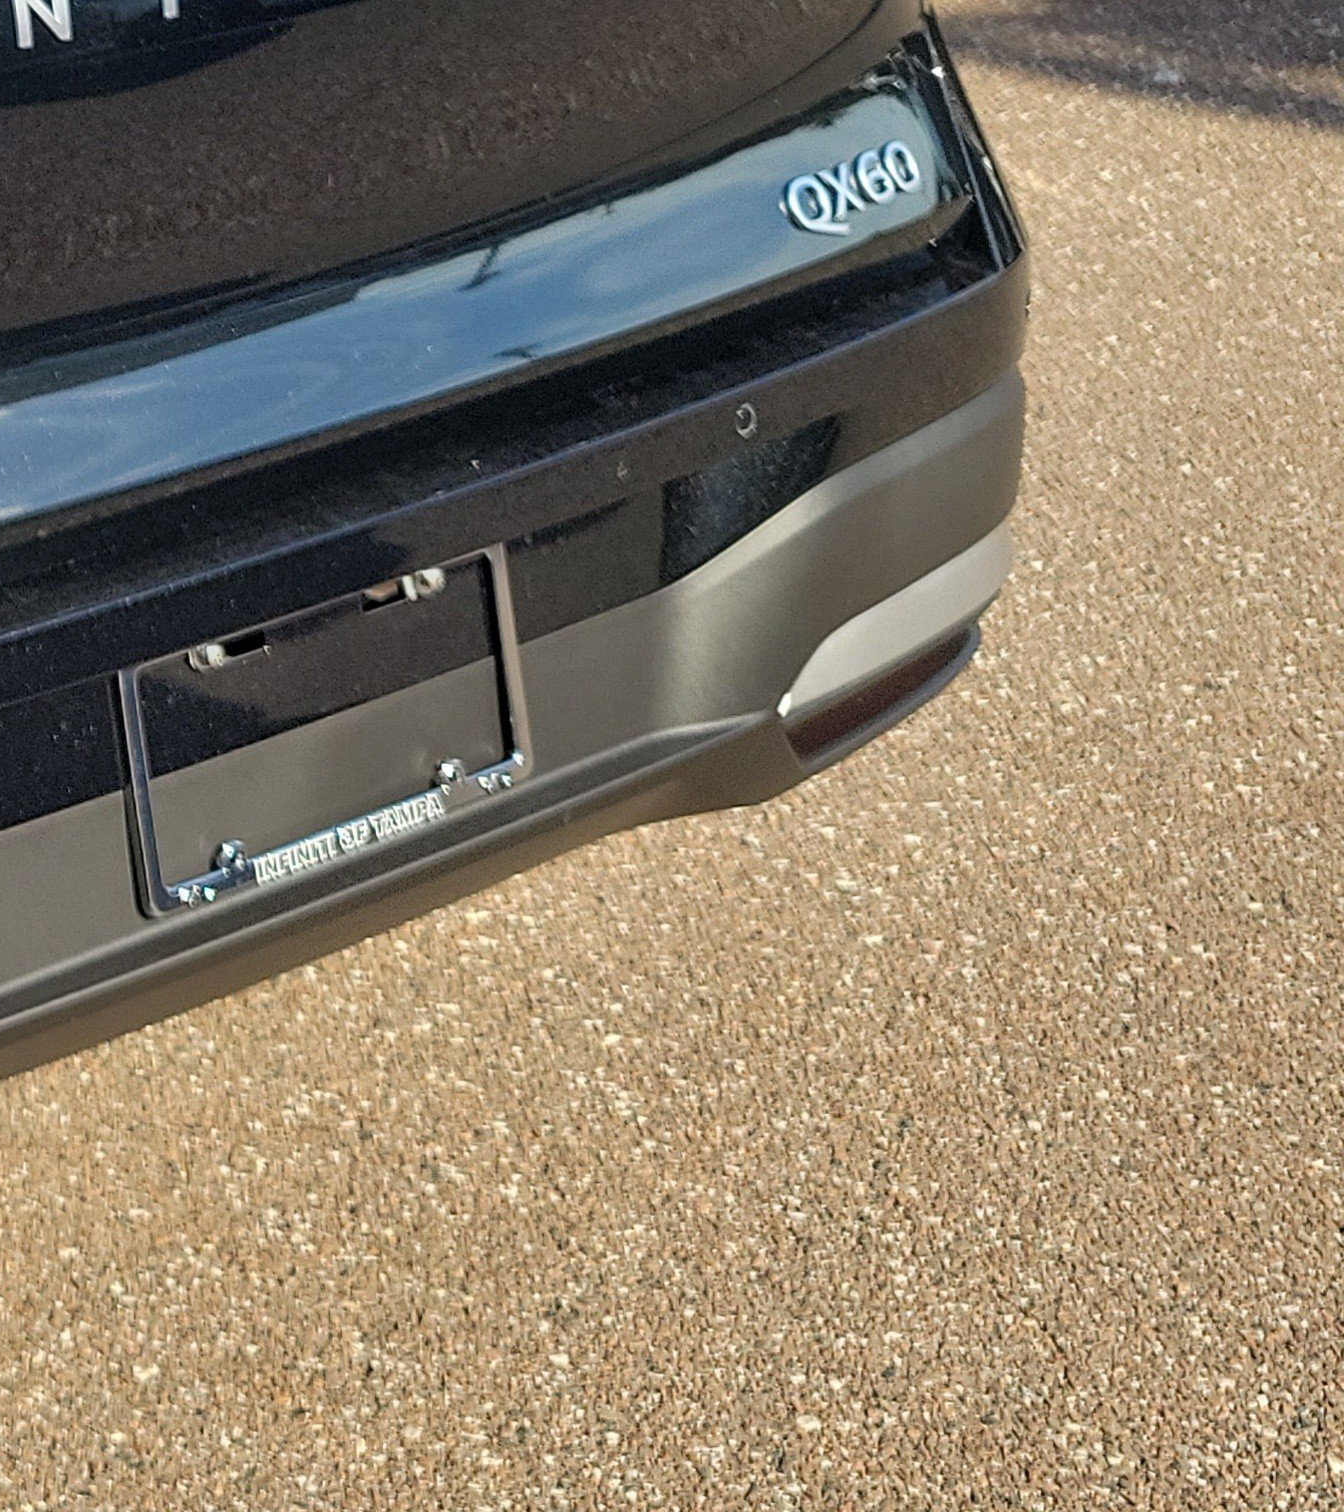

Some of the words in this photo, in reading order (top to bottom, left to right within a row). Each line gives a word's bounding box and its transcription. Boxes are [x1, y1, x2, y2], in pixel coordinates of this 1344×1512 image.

[785, 139, 920, 236] QX60
[253, 832, 338, 886] INFINITI
[368, 792, 445, 838] TAMPA
